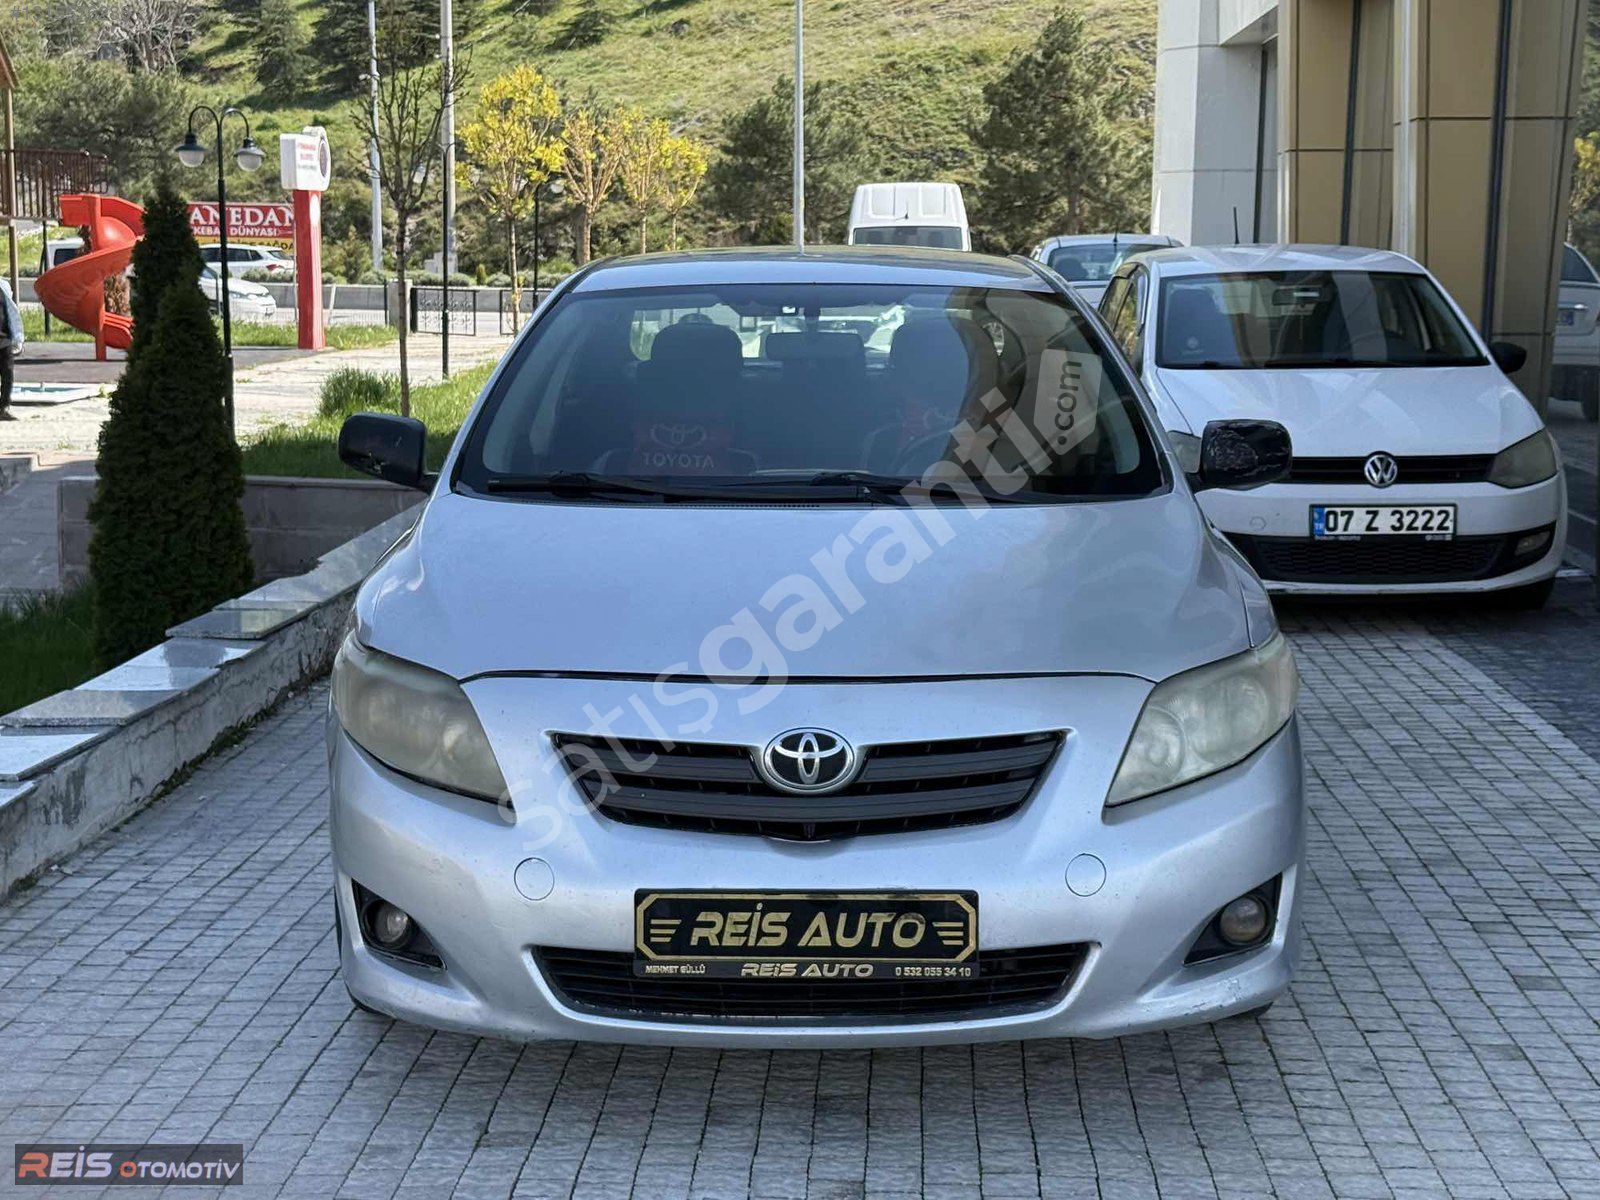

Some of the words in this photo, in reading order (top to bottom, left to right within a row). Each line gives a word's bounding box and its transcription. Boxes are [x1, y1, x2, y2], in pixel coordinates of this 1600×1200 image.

[189, 206, 294, 226] ANEDAN
[192, 226, 220, 236] KEBA
[230, 225, 277, 236] DÜNYASI
[641, 452, 714, 468] TOYOTA
[1325, 510, 1354, 532] 07
[1365, 510, 1379, 532] Z
[1390, 510, 1450, 532] 3222
[690, 902, 792, 947] REİS
[797, 911, 926, 948] AUTO
[645, 965, 679, 974] MEHMET
[680, 963, 706, 974] GÜLLÜ
[801, 963, 874, 977] AUTO
[895, 967, 902, 976] 0
[903, 967, 922, 976] 532
[924, 967, 943, 976] 055
[944, 967, 957, 976] 34
[959, 967, 971, 977] 10
